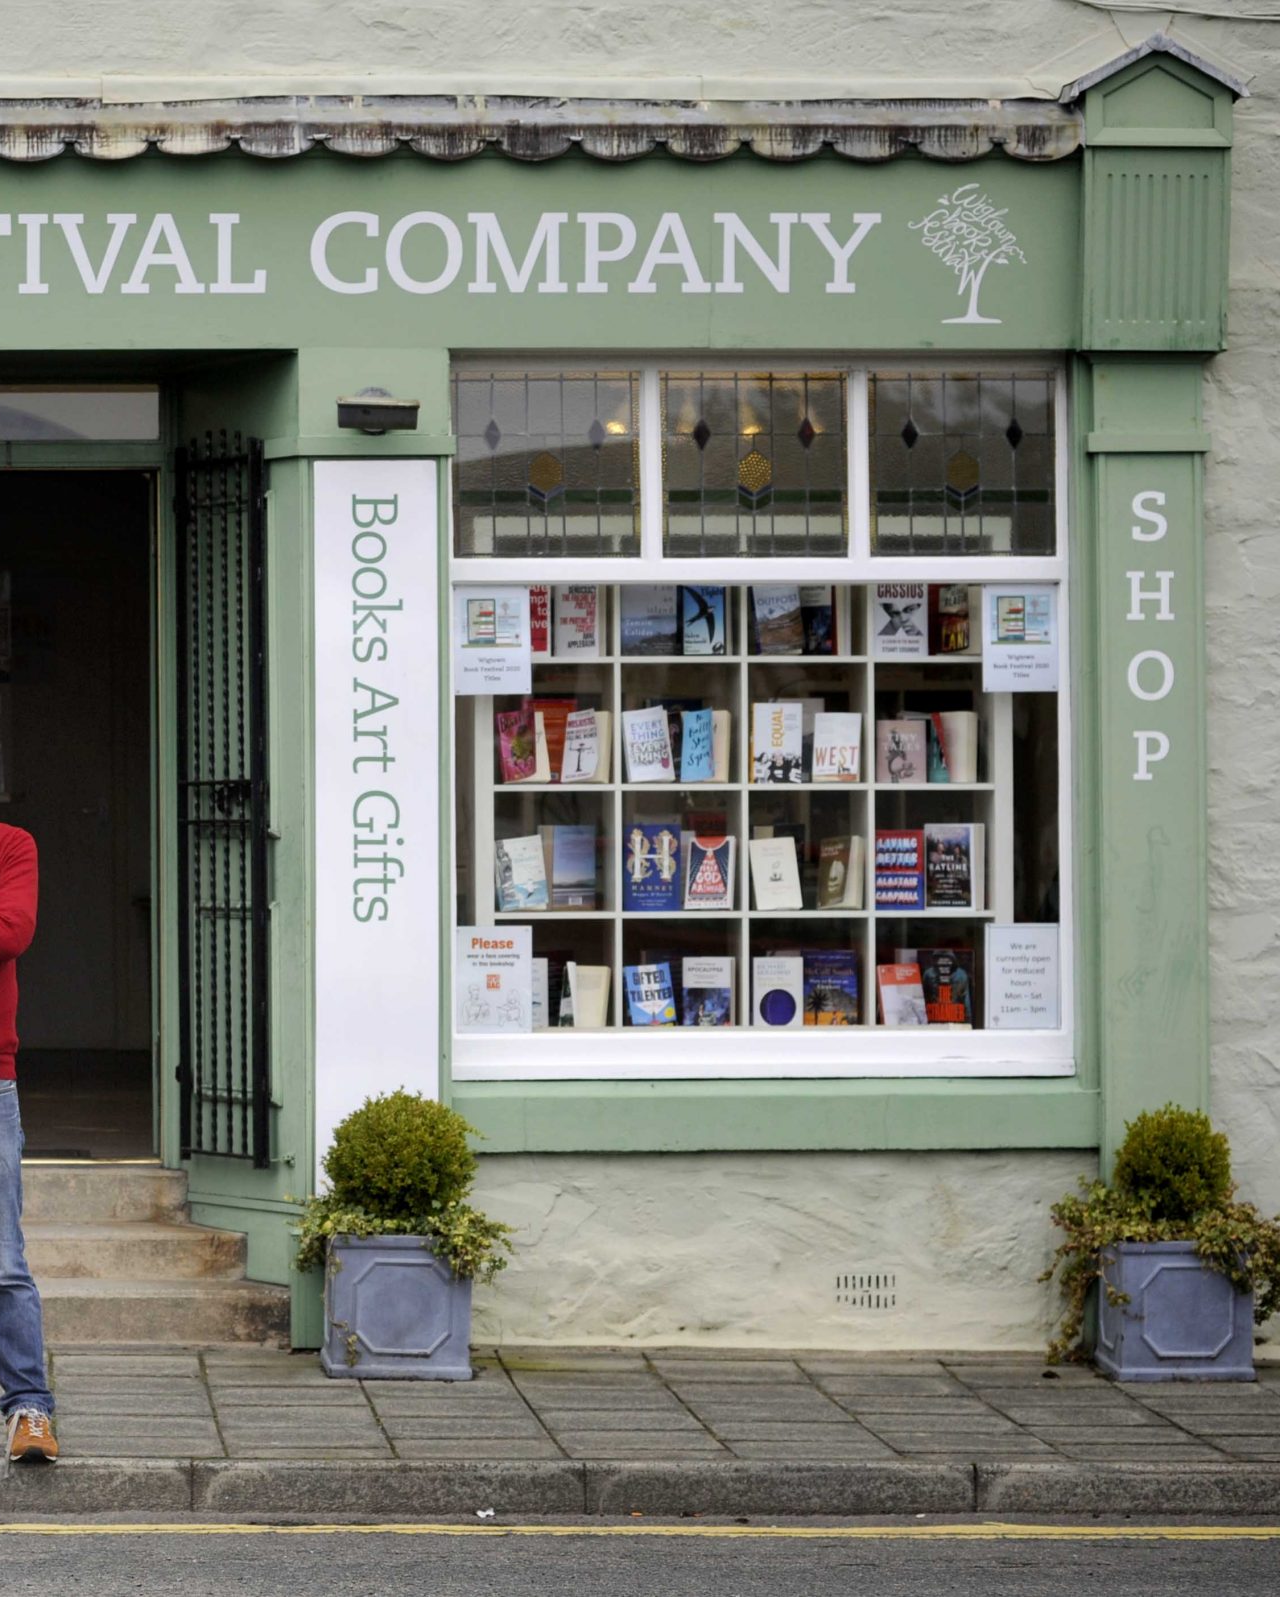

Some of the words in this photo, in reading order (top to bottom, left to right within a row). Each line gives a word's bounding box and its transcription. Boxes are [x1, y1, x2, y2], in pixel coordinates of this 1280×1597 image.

[310, 211, 882, 294] COMPANY
[351, 493, 403, 663] Books
[877, 583, 923, 598] CASSIUS
[1126, 491, 1175, 780] SHOP
[352, 677, 400, 774] Art
[772, 708, 784, 748] EQUAL
[816, 746, 859, 767] WEST
[877, 838, 918, 850] LIVING
[352, 790, 404, 923] Gifts
[876, 853, 918, 865] BETTER
[876, 877, 918, 888] ALASTAIR
[876, 891, 919, 902] CAMPBELL
[472, 938, 514, 949] Please
